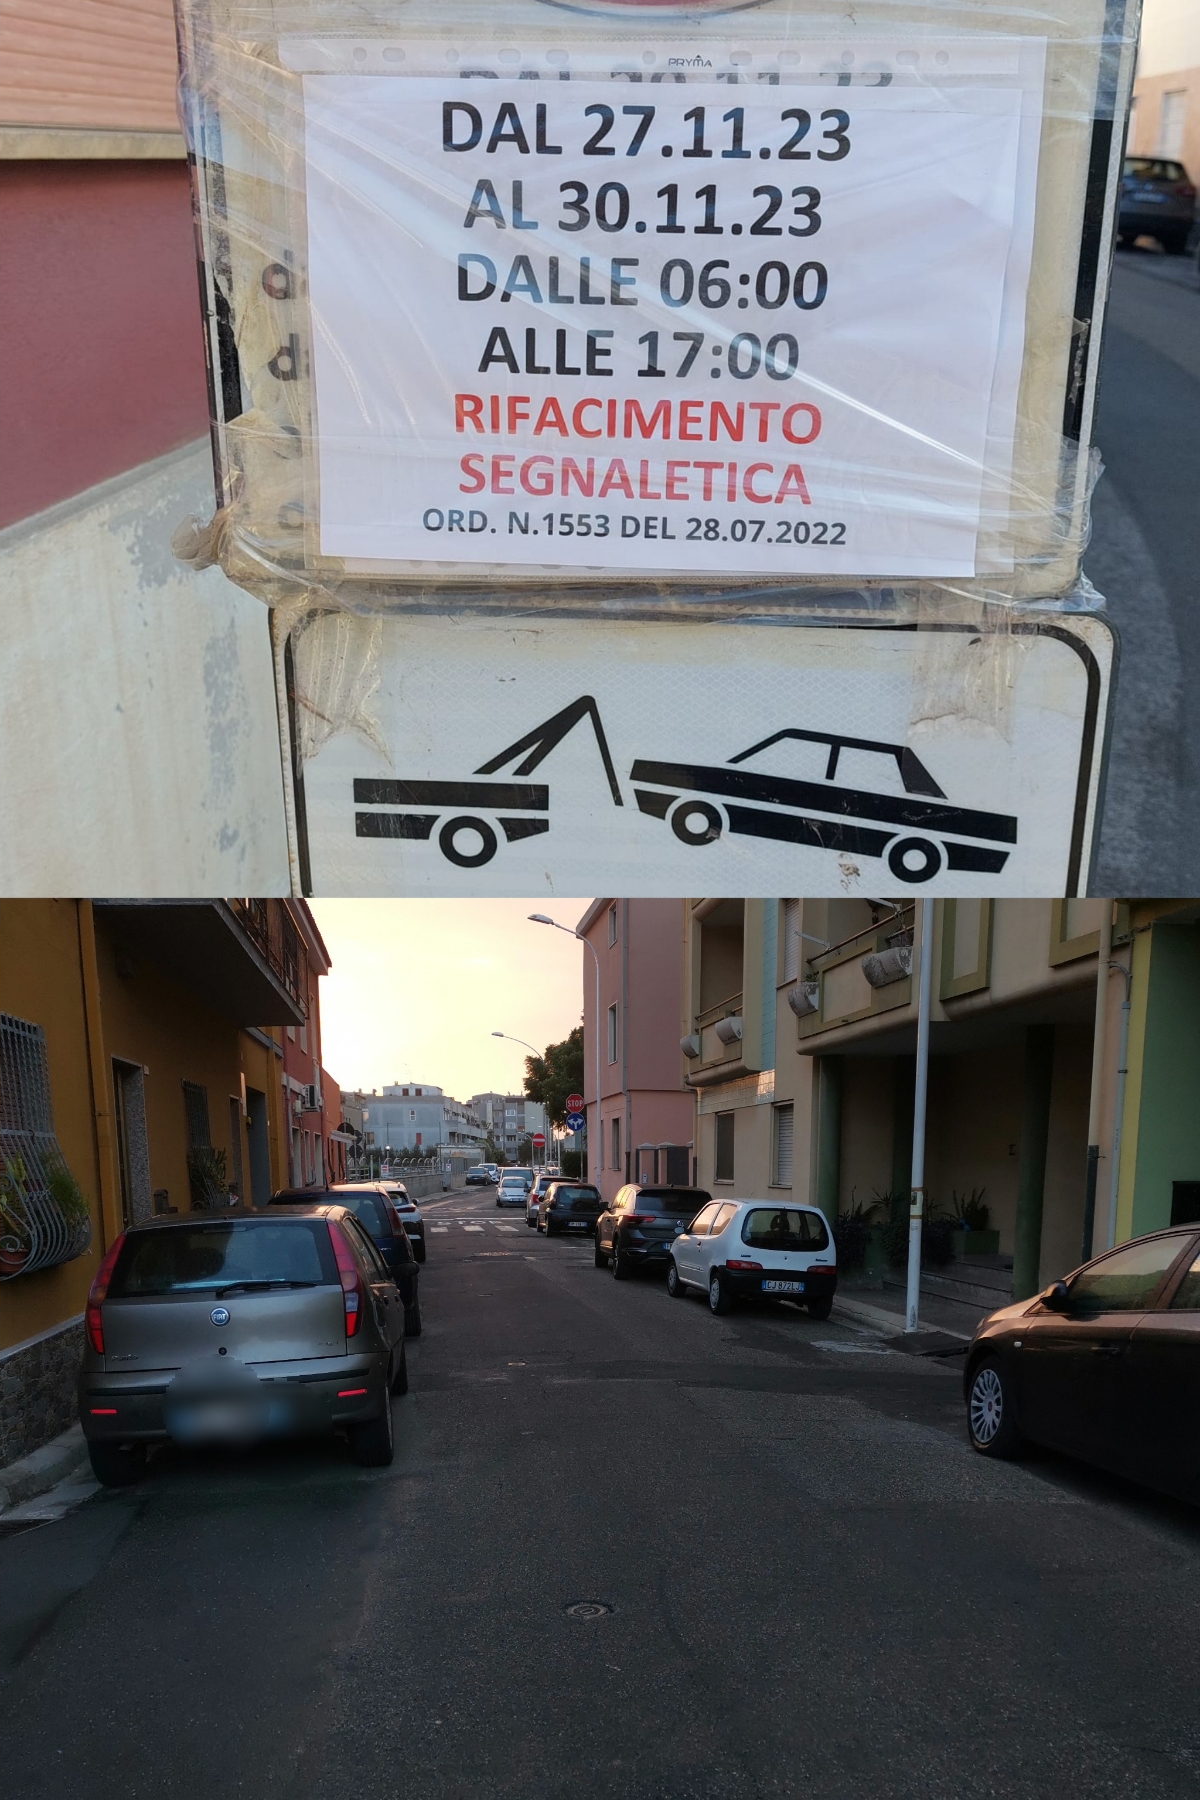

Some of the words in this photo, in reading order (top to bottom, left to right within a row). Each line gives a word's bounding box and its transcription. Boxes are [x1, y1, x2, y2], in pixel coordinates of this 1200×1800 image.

[668, 54, 712, 68] PRYMA
[443, 101, 562, 154] DAL
[583, 104, 851, 161] 27.11.23
[463, 179, 538, 229] AL
[559, 181, 822, 238] 30.11.23
[457, 253, 640, 306] DALLE
[659, 259, 829, 310] 06:00
[478, 327, 614, 376] ALLE
[638, 331, 800, 380] 17:00
[454, 393, 823, 444] RIFACIMENTO
[459, 453, 812, 505] SEGNALETICA
[422, 508, 497, 535] ORD.
[508, 511, 610, 538] N.1553
[620, 515, 677, 540] DEL
[685, 518, 847, 546] 28.07.2022
